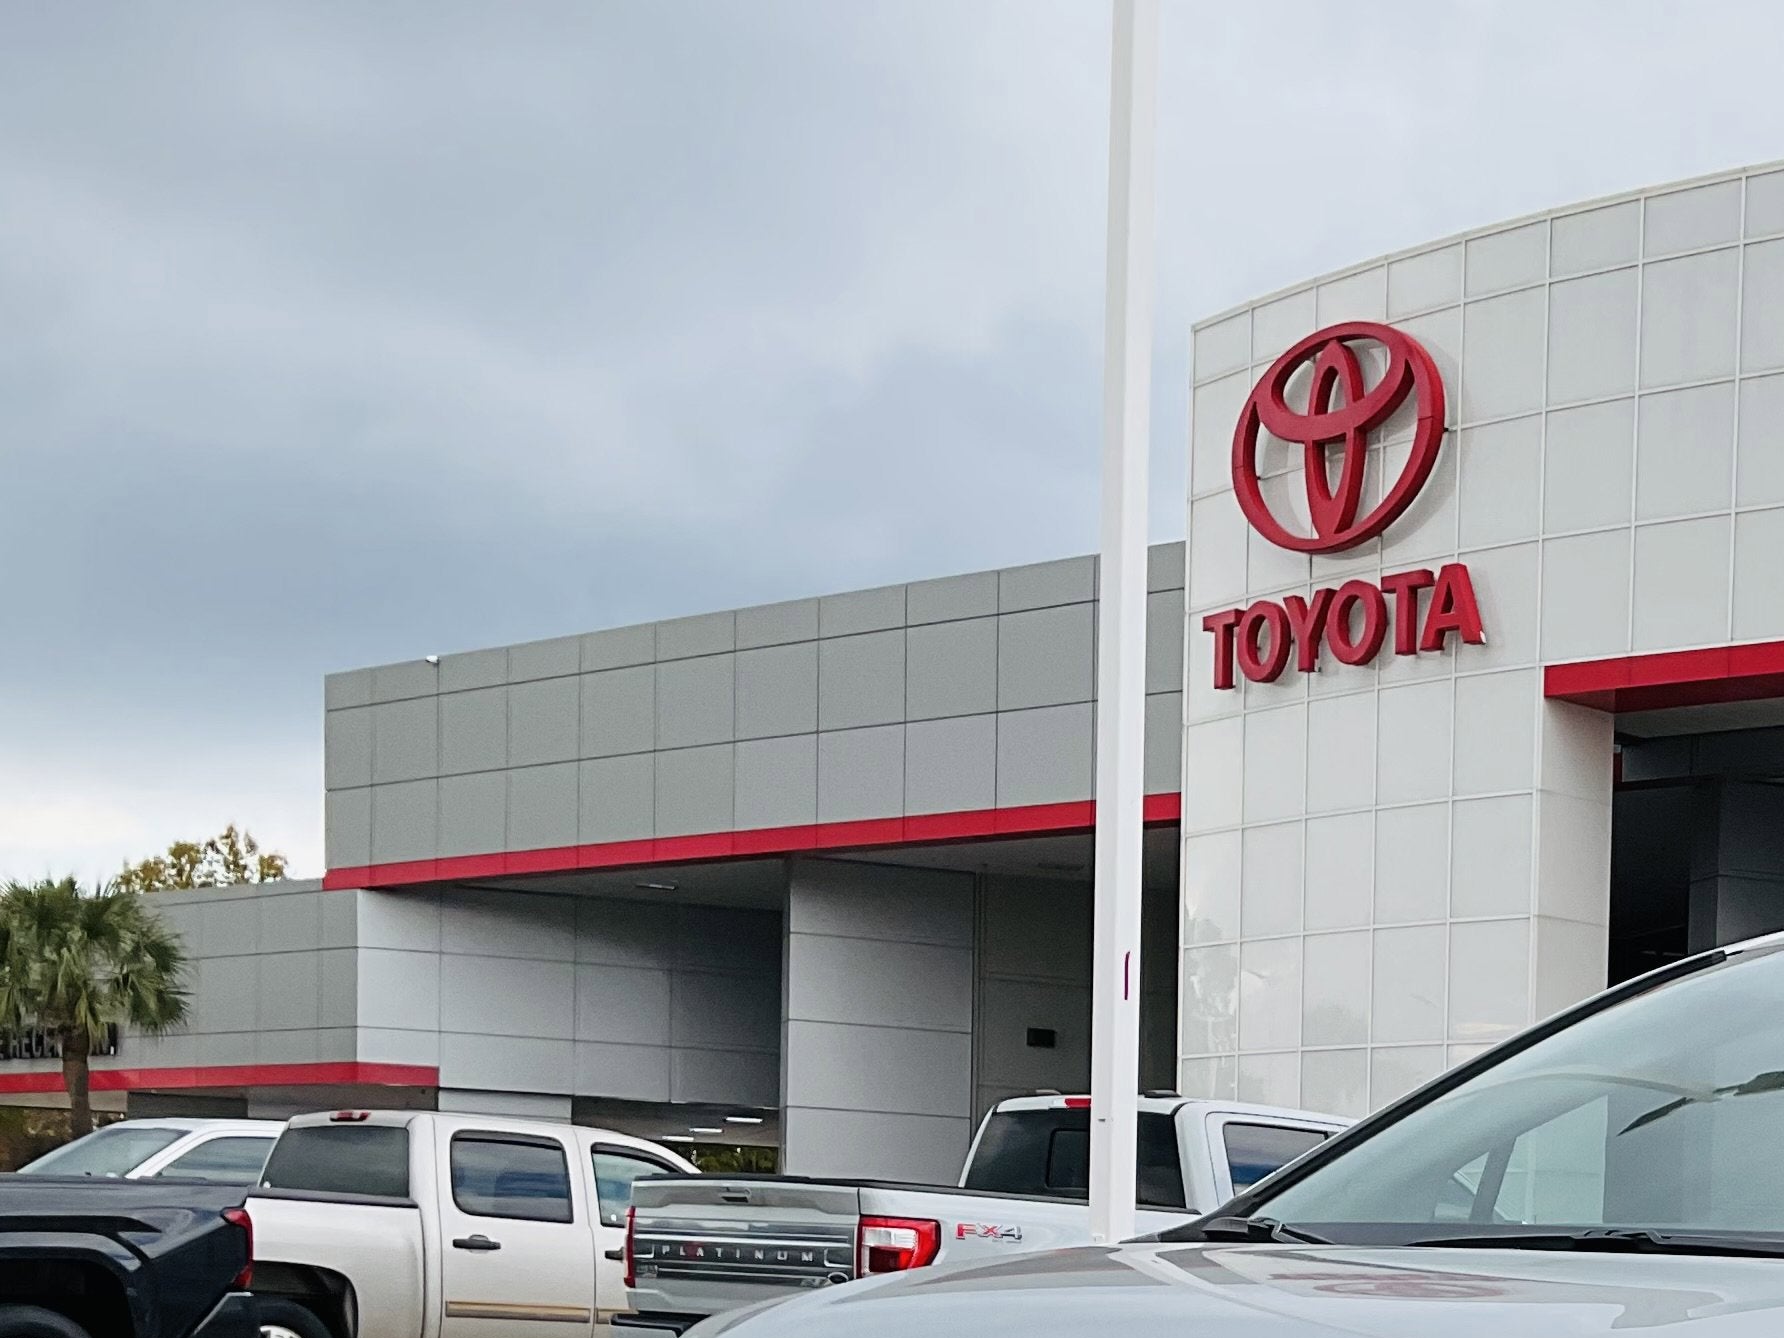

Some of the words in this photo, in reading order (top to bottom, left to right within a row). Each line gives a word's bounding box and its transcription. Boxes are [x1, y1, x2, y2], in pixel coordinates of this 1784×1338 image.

[1203, 563, 1485, 689] TOYOTA
[956, 1223, 1022, 1240] FX4
[661, 1245, 813, 1262] PLATINUM
